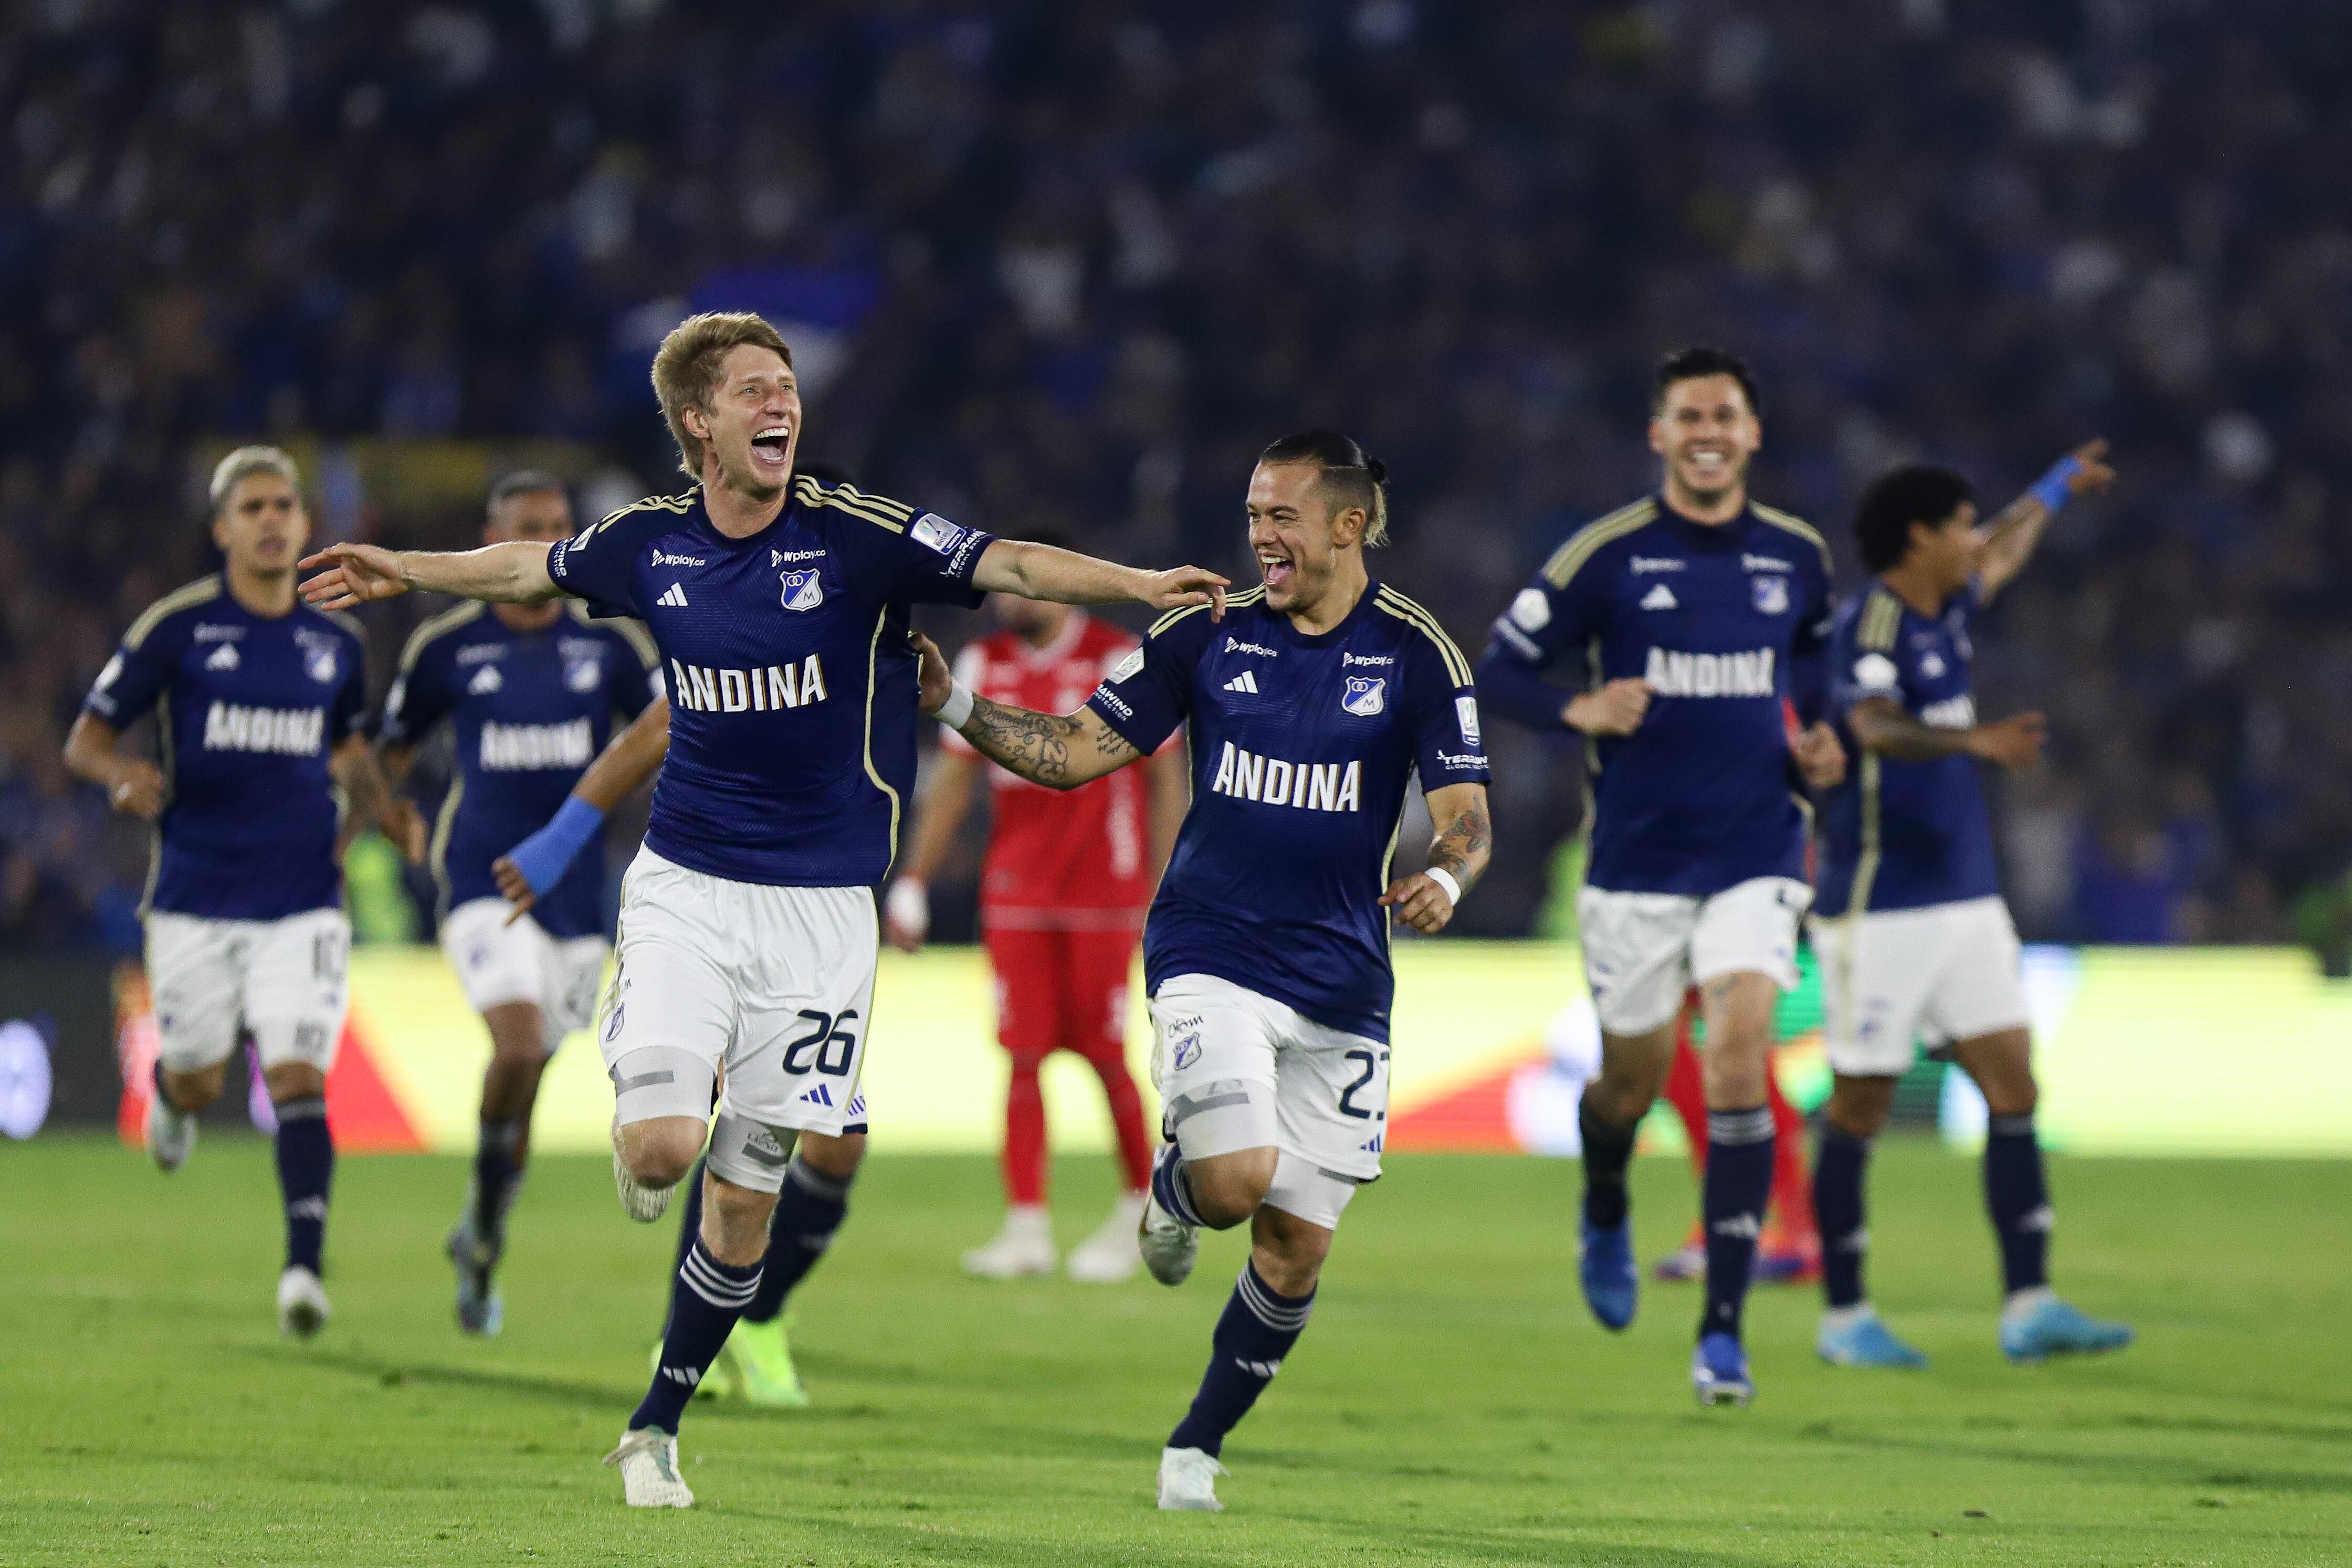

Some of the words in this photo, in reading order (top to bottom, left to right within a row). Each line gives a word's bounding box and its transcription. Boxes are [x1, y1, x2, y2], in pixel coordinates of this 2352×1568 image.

[665, 554, 706, 567] Wplay.co
[784, 550, 826, 563] Wplay.co
[671, 653, 827, 713] ANDINA
[1212, 740, 1360, 812] ANDINA
[782, 1009, 858, 1077] 26
[1339, 1050, 1389, 1121] 2
